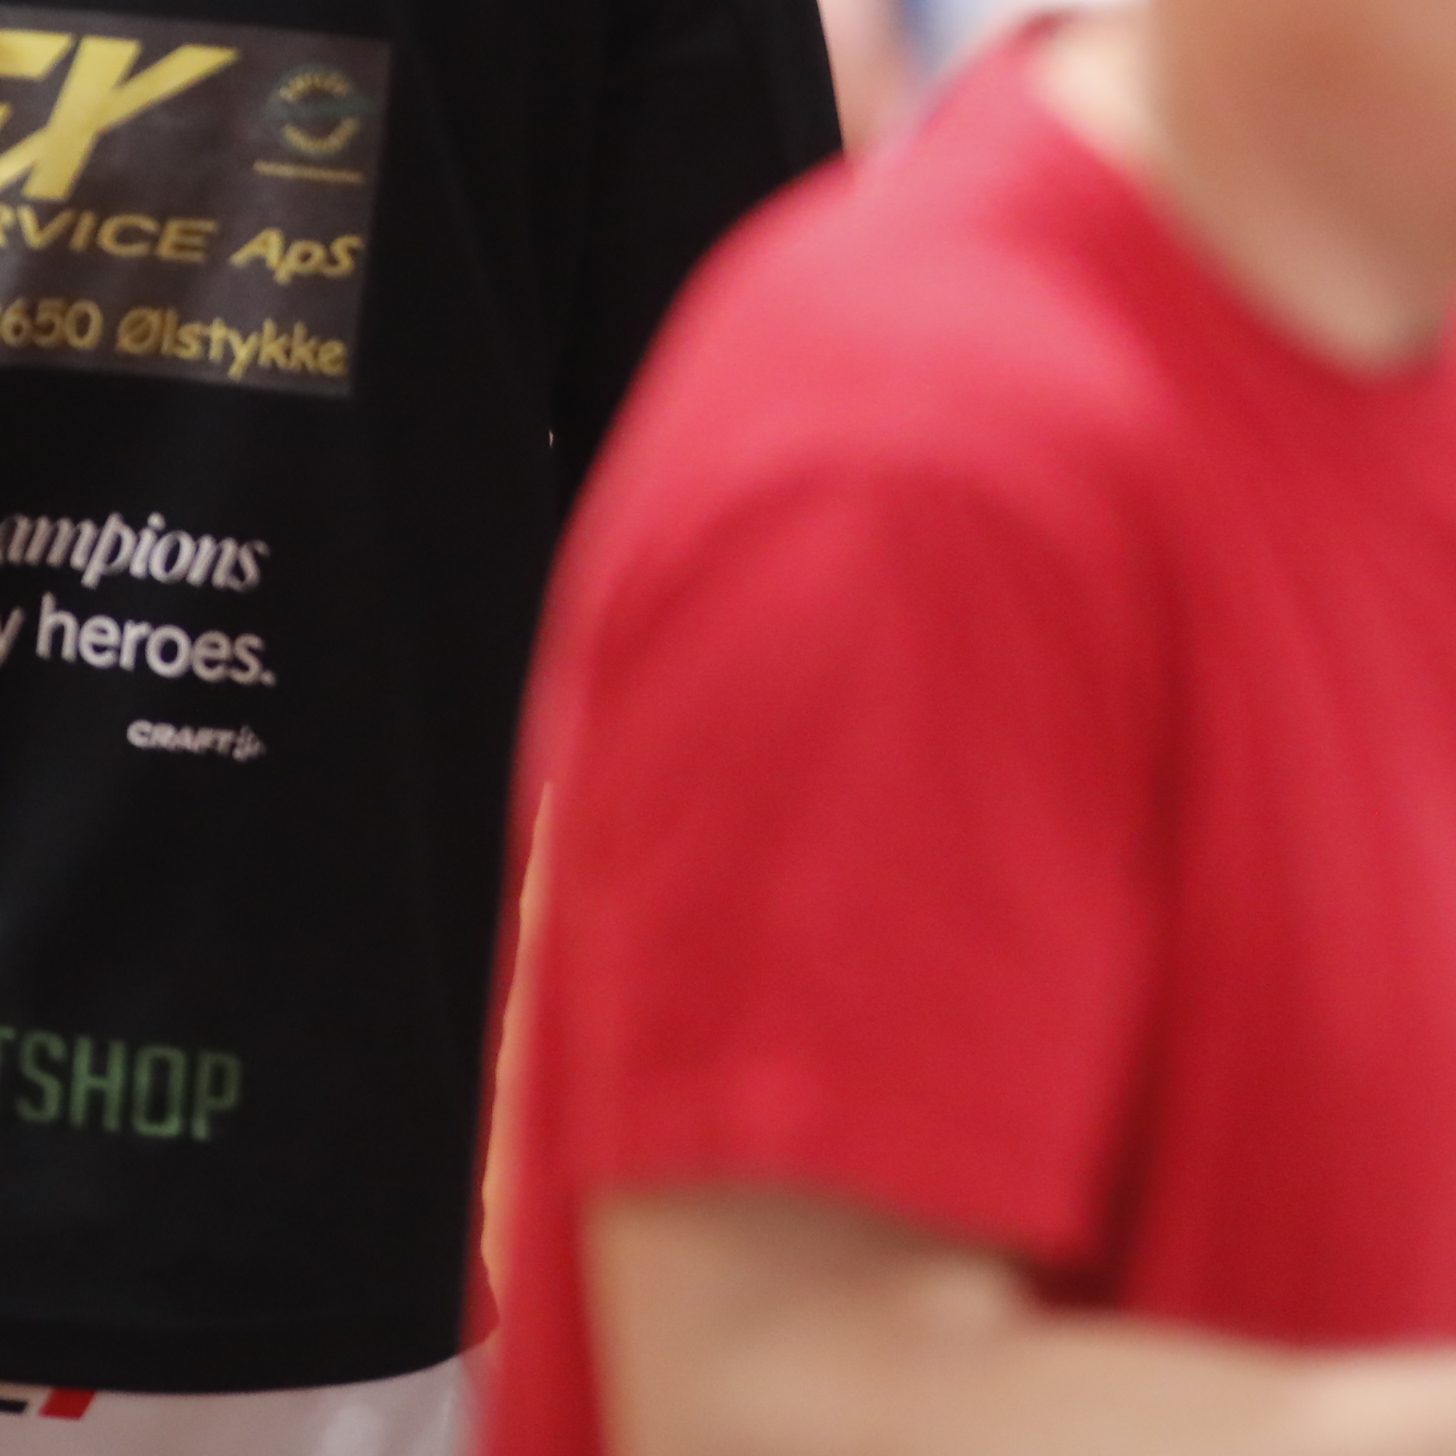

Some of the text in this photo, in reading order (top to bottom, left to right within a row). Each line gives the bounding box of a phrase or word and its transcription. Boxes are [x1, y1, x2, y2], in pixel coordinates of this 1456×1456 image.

[229, 226, 363, 284] Aps
[116, 306, 349, 380] Ølstykke
[35, 591, 277, 686] heroes.
